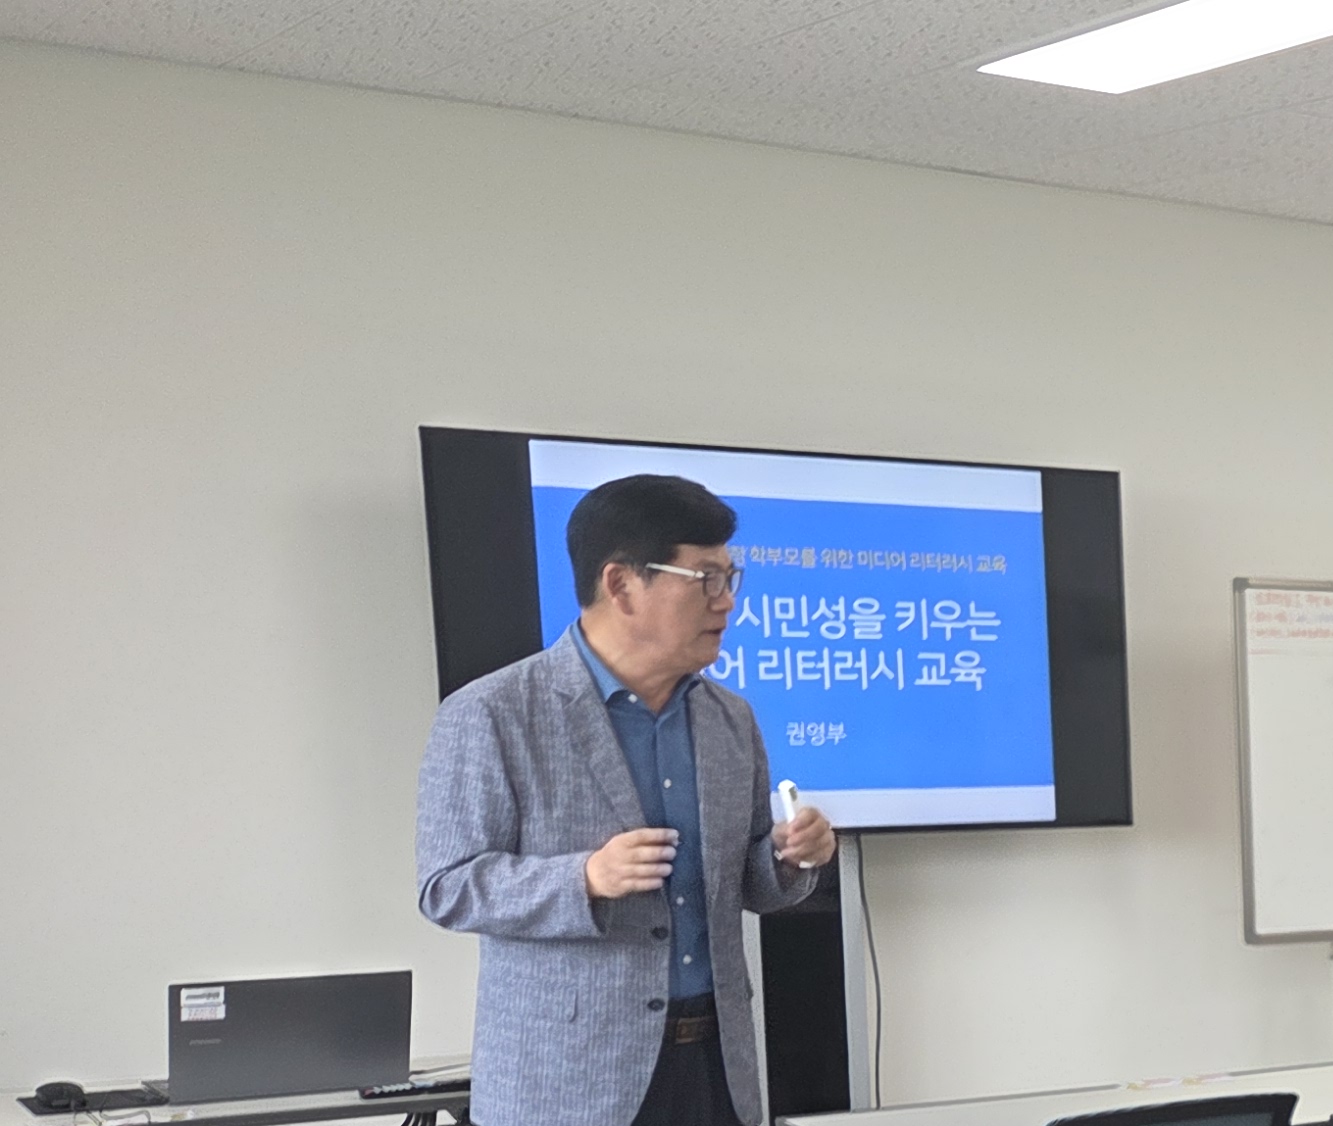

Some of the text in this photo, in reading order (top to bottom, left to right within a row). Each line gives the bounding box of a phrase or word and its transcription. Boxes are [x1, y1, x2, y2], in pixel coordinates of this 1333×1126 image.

[749, 545, 817, 568] 학부모를
[821, 547, 853, 569] 위한
[857, 549, 907, 571] 미디어
[910, 551, 973, 574] 리터러시
[976, 554, 1008, 575] 교육
[735, 593, 1002, 641] 시민성을 키우는
[699, 645, 987, 692] 어 리터러시 교육
